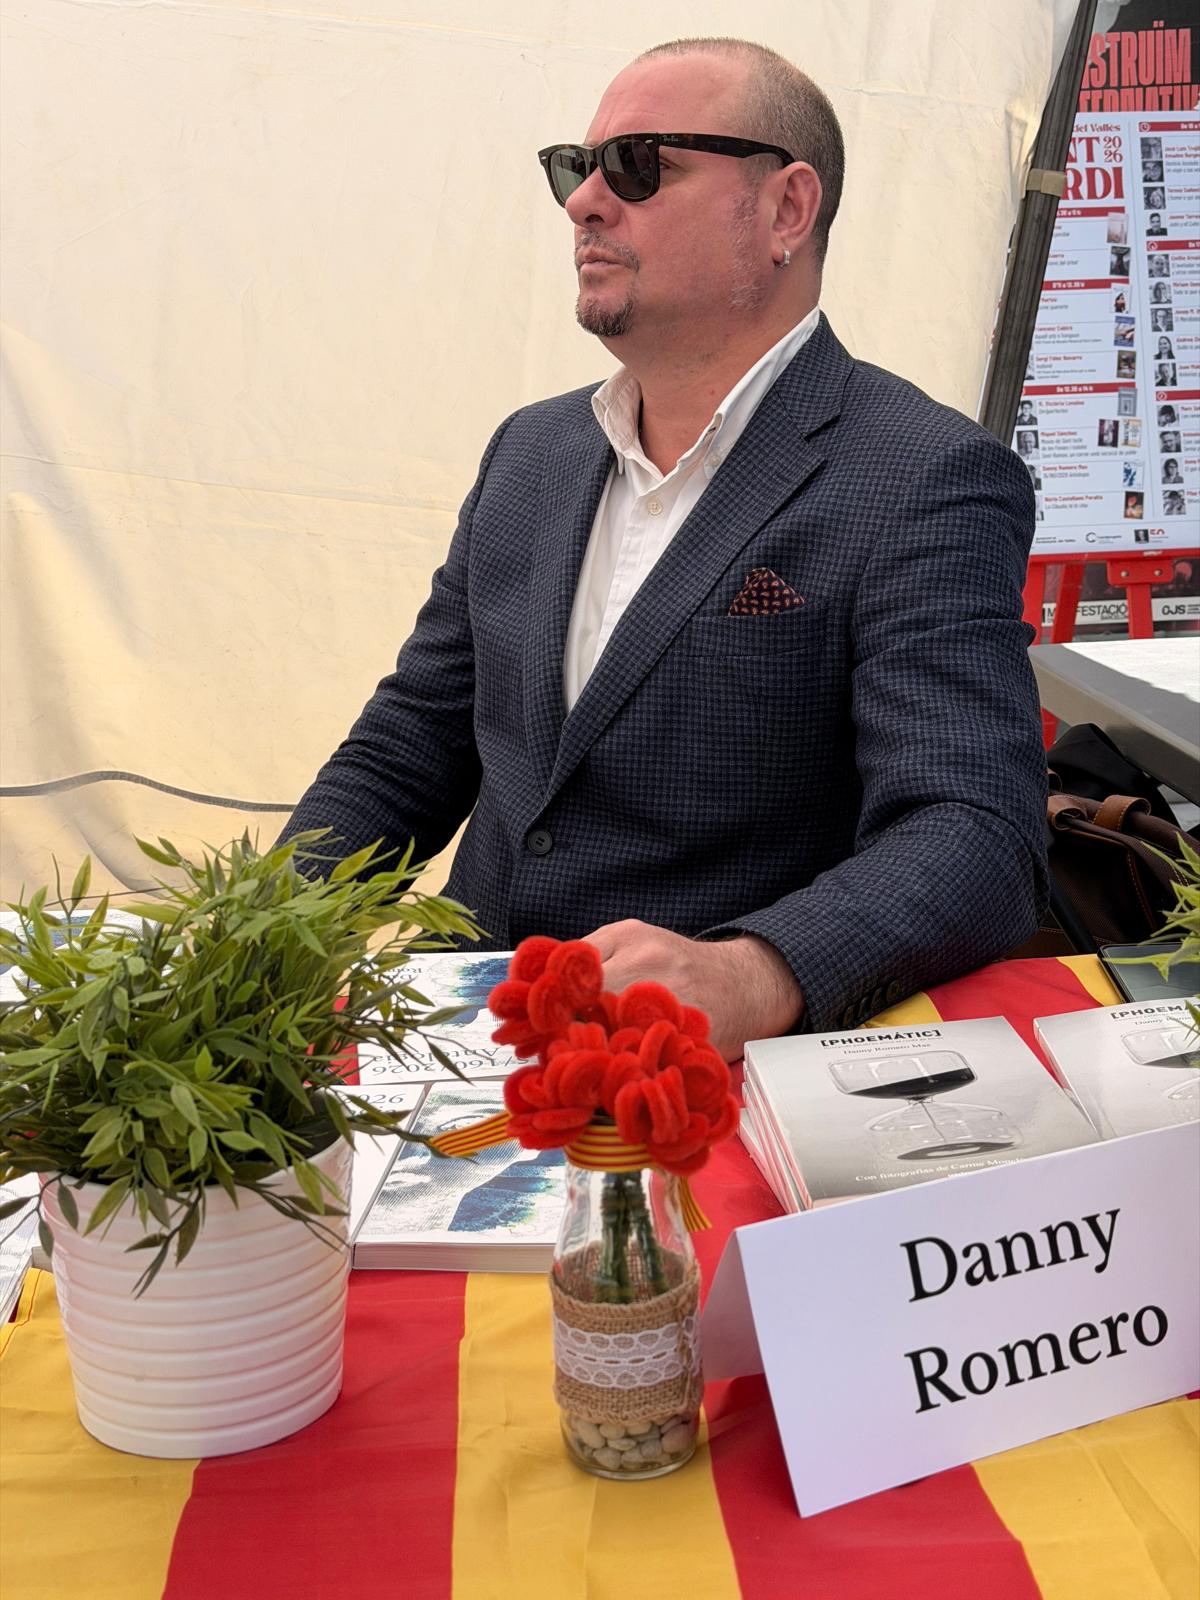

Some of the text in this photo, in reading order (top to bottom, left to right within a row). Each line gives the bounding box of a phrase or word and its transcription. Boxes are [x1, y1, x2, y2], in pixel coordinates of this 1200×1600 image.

[1103, 136, 1122, 149] 20
[1104, 149, 1123, 163] 26
[900, 1208, 1121, 1303] Danny
[904, 1303, 1168, 1414] Romero
